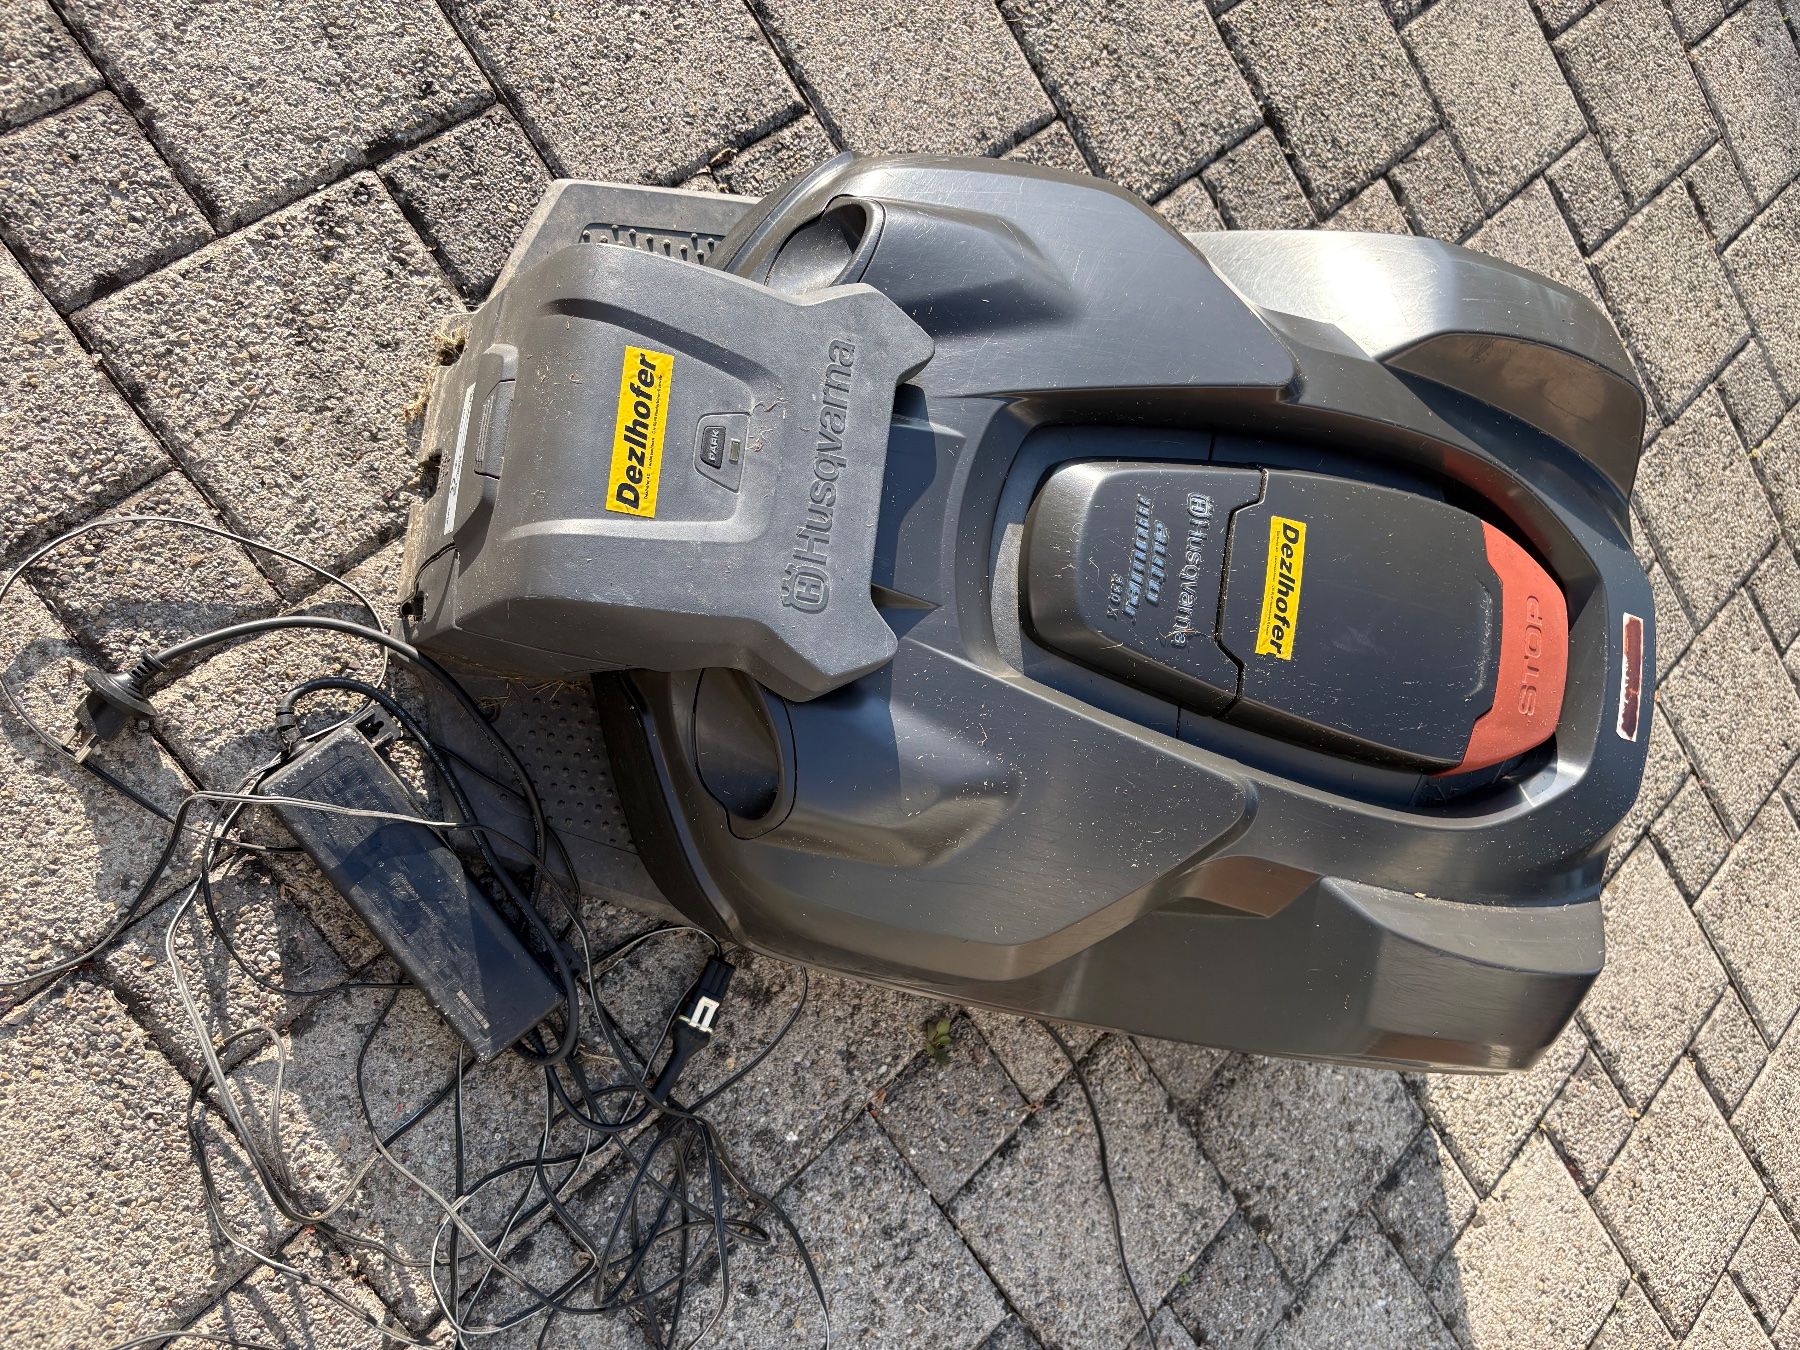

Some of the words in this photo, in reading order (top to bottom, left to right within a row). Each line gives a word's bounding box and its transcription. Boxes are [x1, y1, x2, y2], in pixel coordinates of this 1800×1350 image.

[616, 353, 656, 509] Dezlhofer
[708, 429, 720, 461] PARK
[793, 338, 855, 565] Husqvarna
[1171, 518, 1210, 646] Husqvarna
[1270, 522, 1299, 654] Dezlhofer
[1518, 595, 1543, 716] STOP
